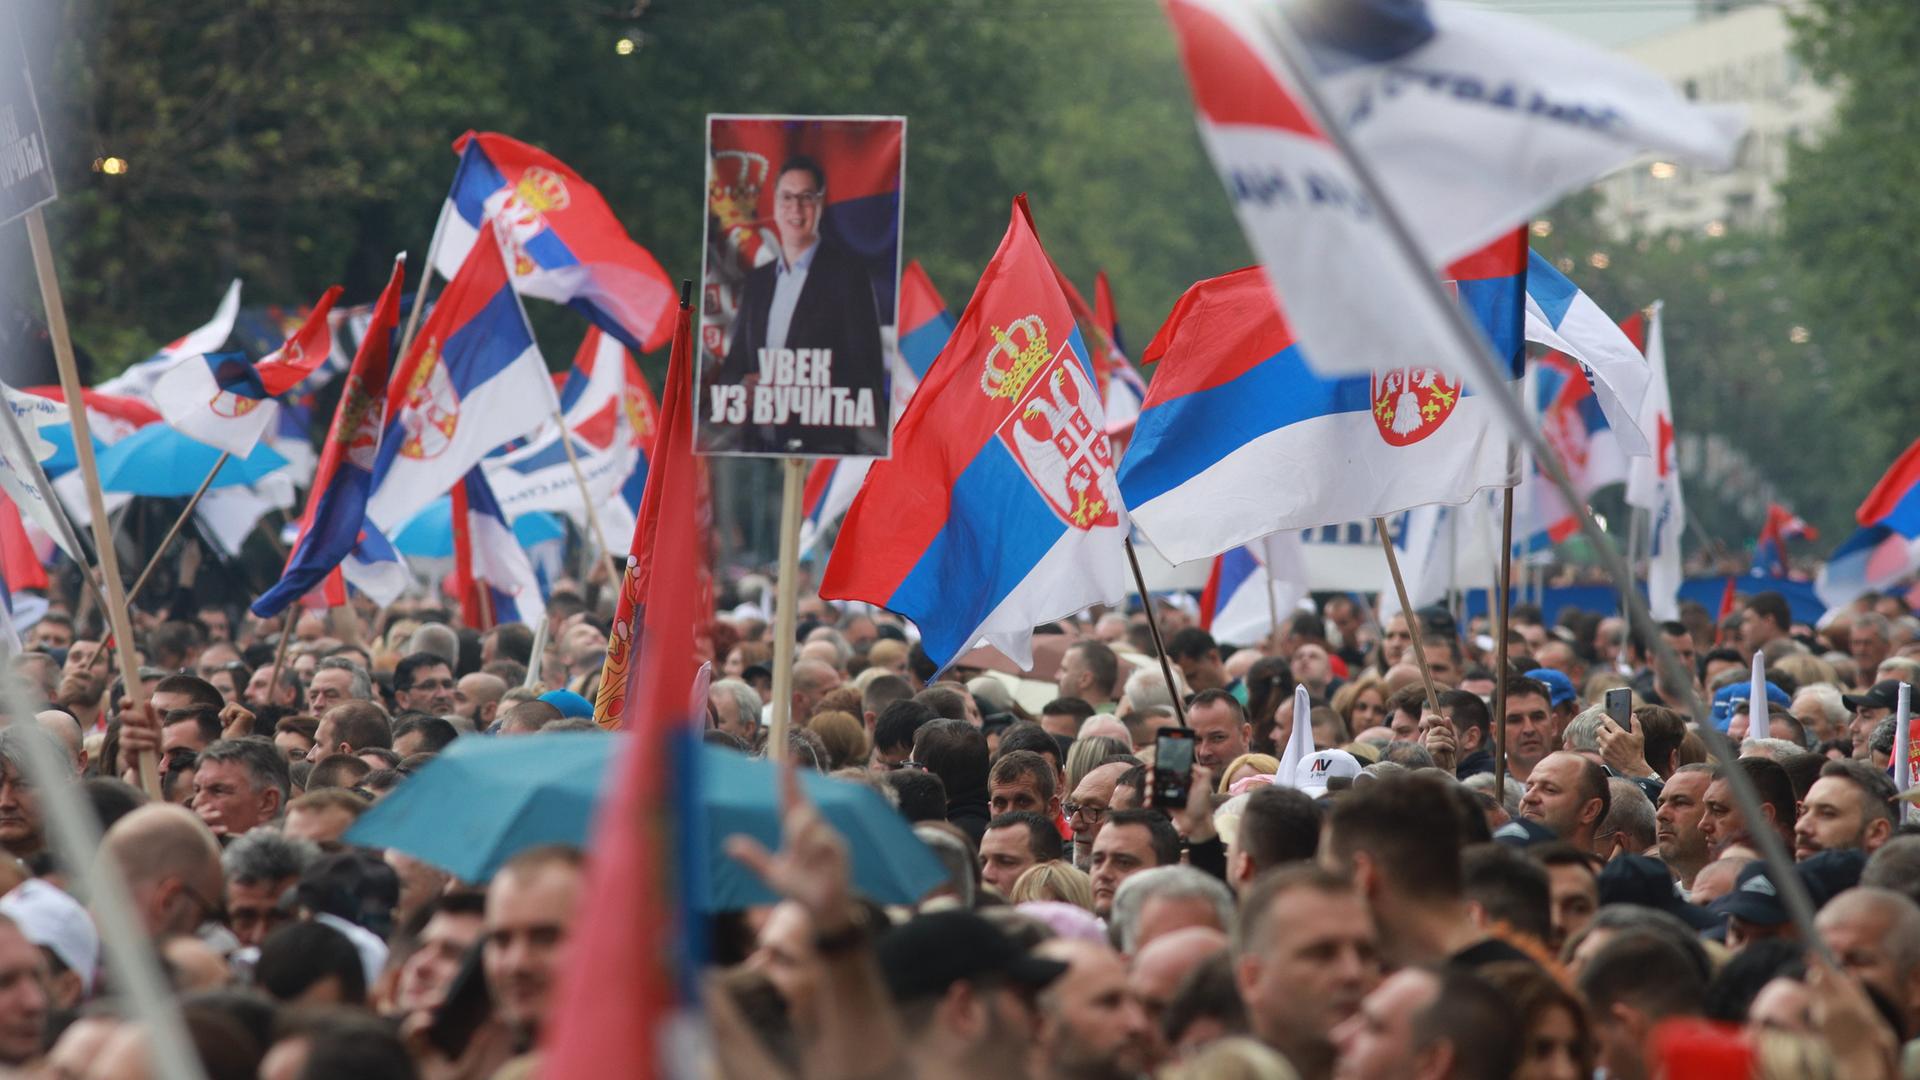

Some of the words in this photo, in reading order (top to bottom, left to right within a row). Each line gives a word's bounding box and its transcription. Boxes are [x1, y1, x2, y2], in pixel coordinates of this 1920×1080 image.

[757, 348, 832, 386] УВЕК
[710, 384, 747, 424] УЗ
[752, 385, 876, 426] ВУЧИЋА
